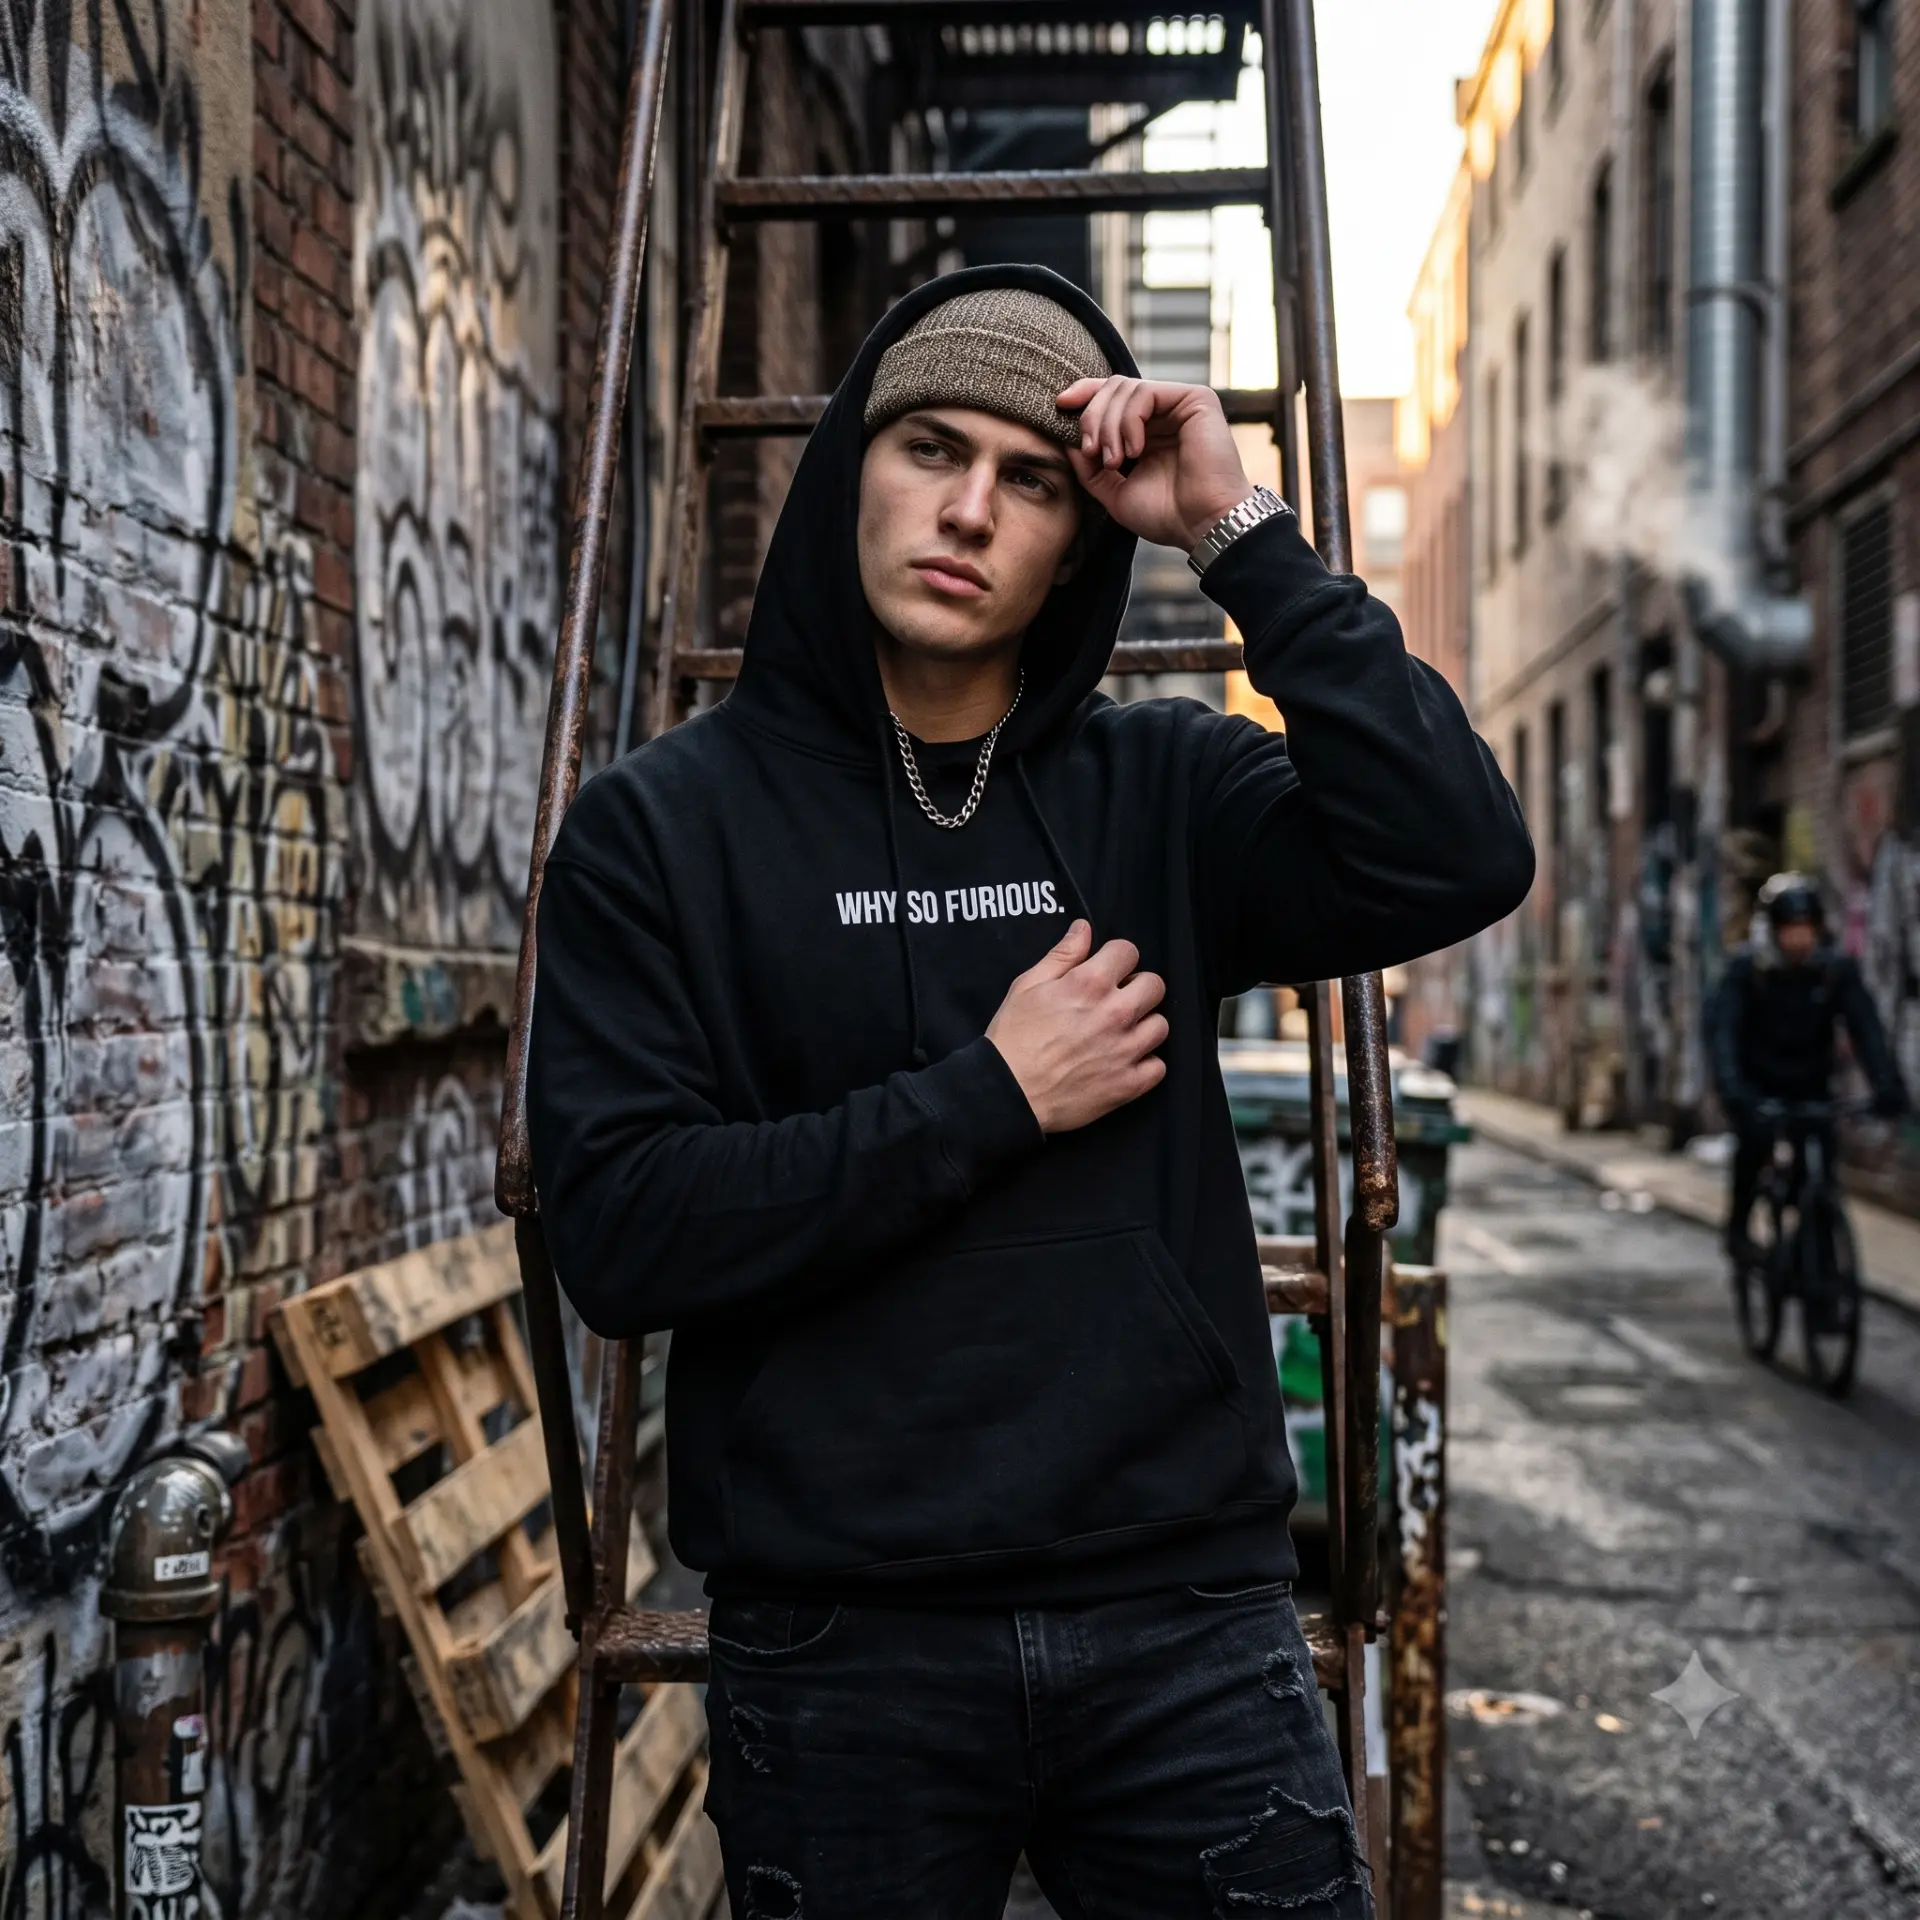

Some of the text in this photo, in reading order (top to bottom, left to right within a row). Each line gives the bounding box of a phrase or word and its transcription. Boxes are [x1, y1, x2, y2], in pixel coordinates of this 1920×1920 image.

[836, 881, 1064, 924] WHY SO FURIOUS.
